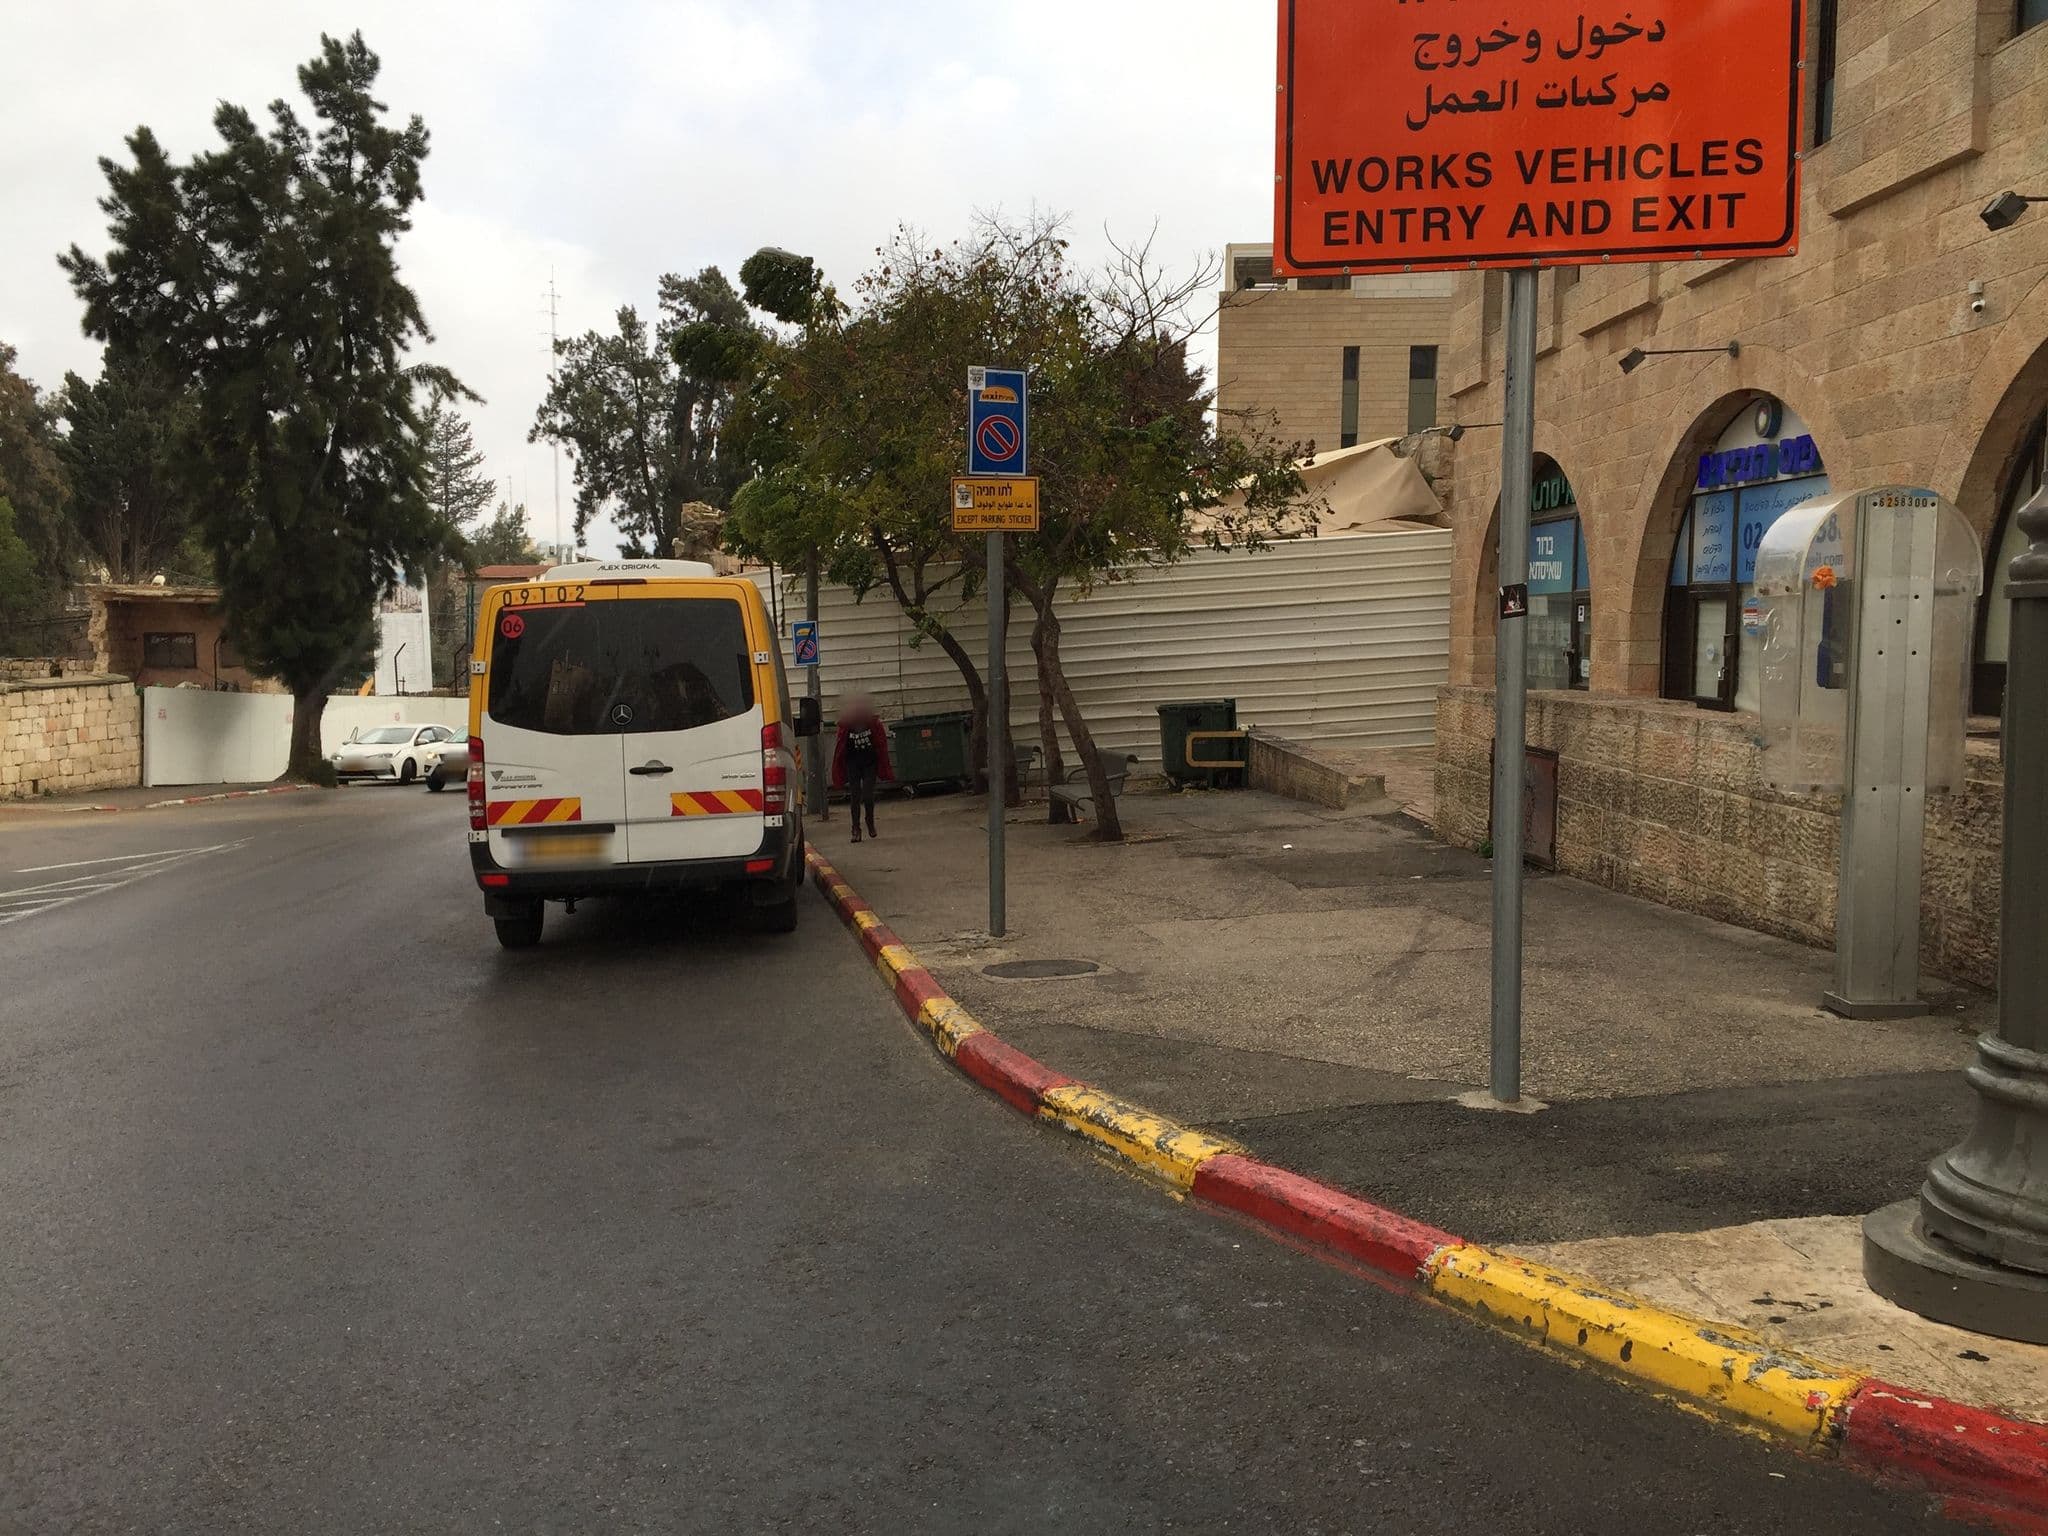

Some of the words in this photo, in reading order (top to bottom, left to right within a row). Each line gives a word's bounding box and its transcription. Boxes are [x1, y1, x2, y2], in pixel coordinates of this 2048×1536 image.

[1412, 19, 1541, 71] وخروج
[1556, 13, 1667, 60] دخول
[1406, 79, 1519, 132] العمل
[1311, 152, 1492, 195] WORKS
[1515, 138, 1764, 185] VEHICLES
[1323, 204, 1486, 247] ENTRY
[1506, 199, 1612, 239] AND
[1631, 192, 1747, 233] EXIT
[957, 515, 978, 524] EXCEPT
[980, 515, 1005, 524] PARKING
[1009, 515, 1032, 524] STICKER
[597, 564, 620, 572] ALEX
[621, 563, 661, 571] ORIGINAL
[503, 619, 522, 634] 06
